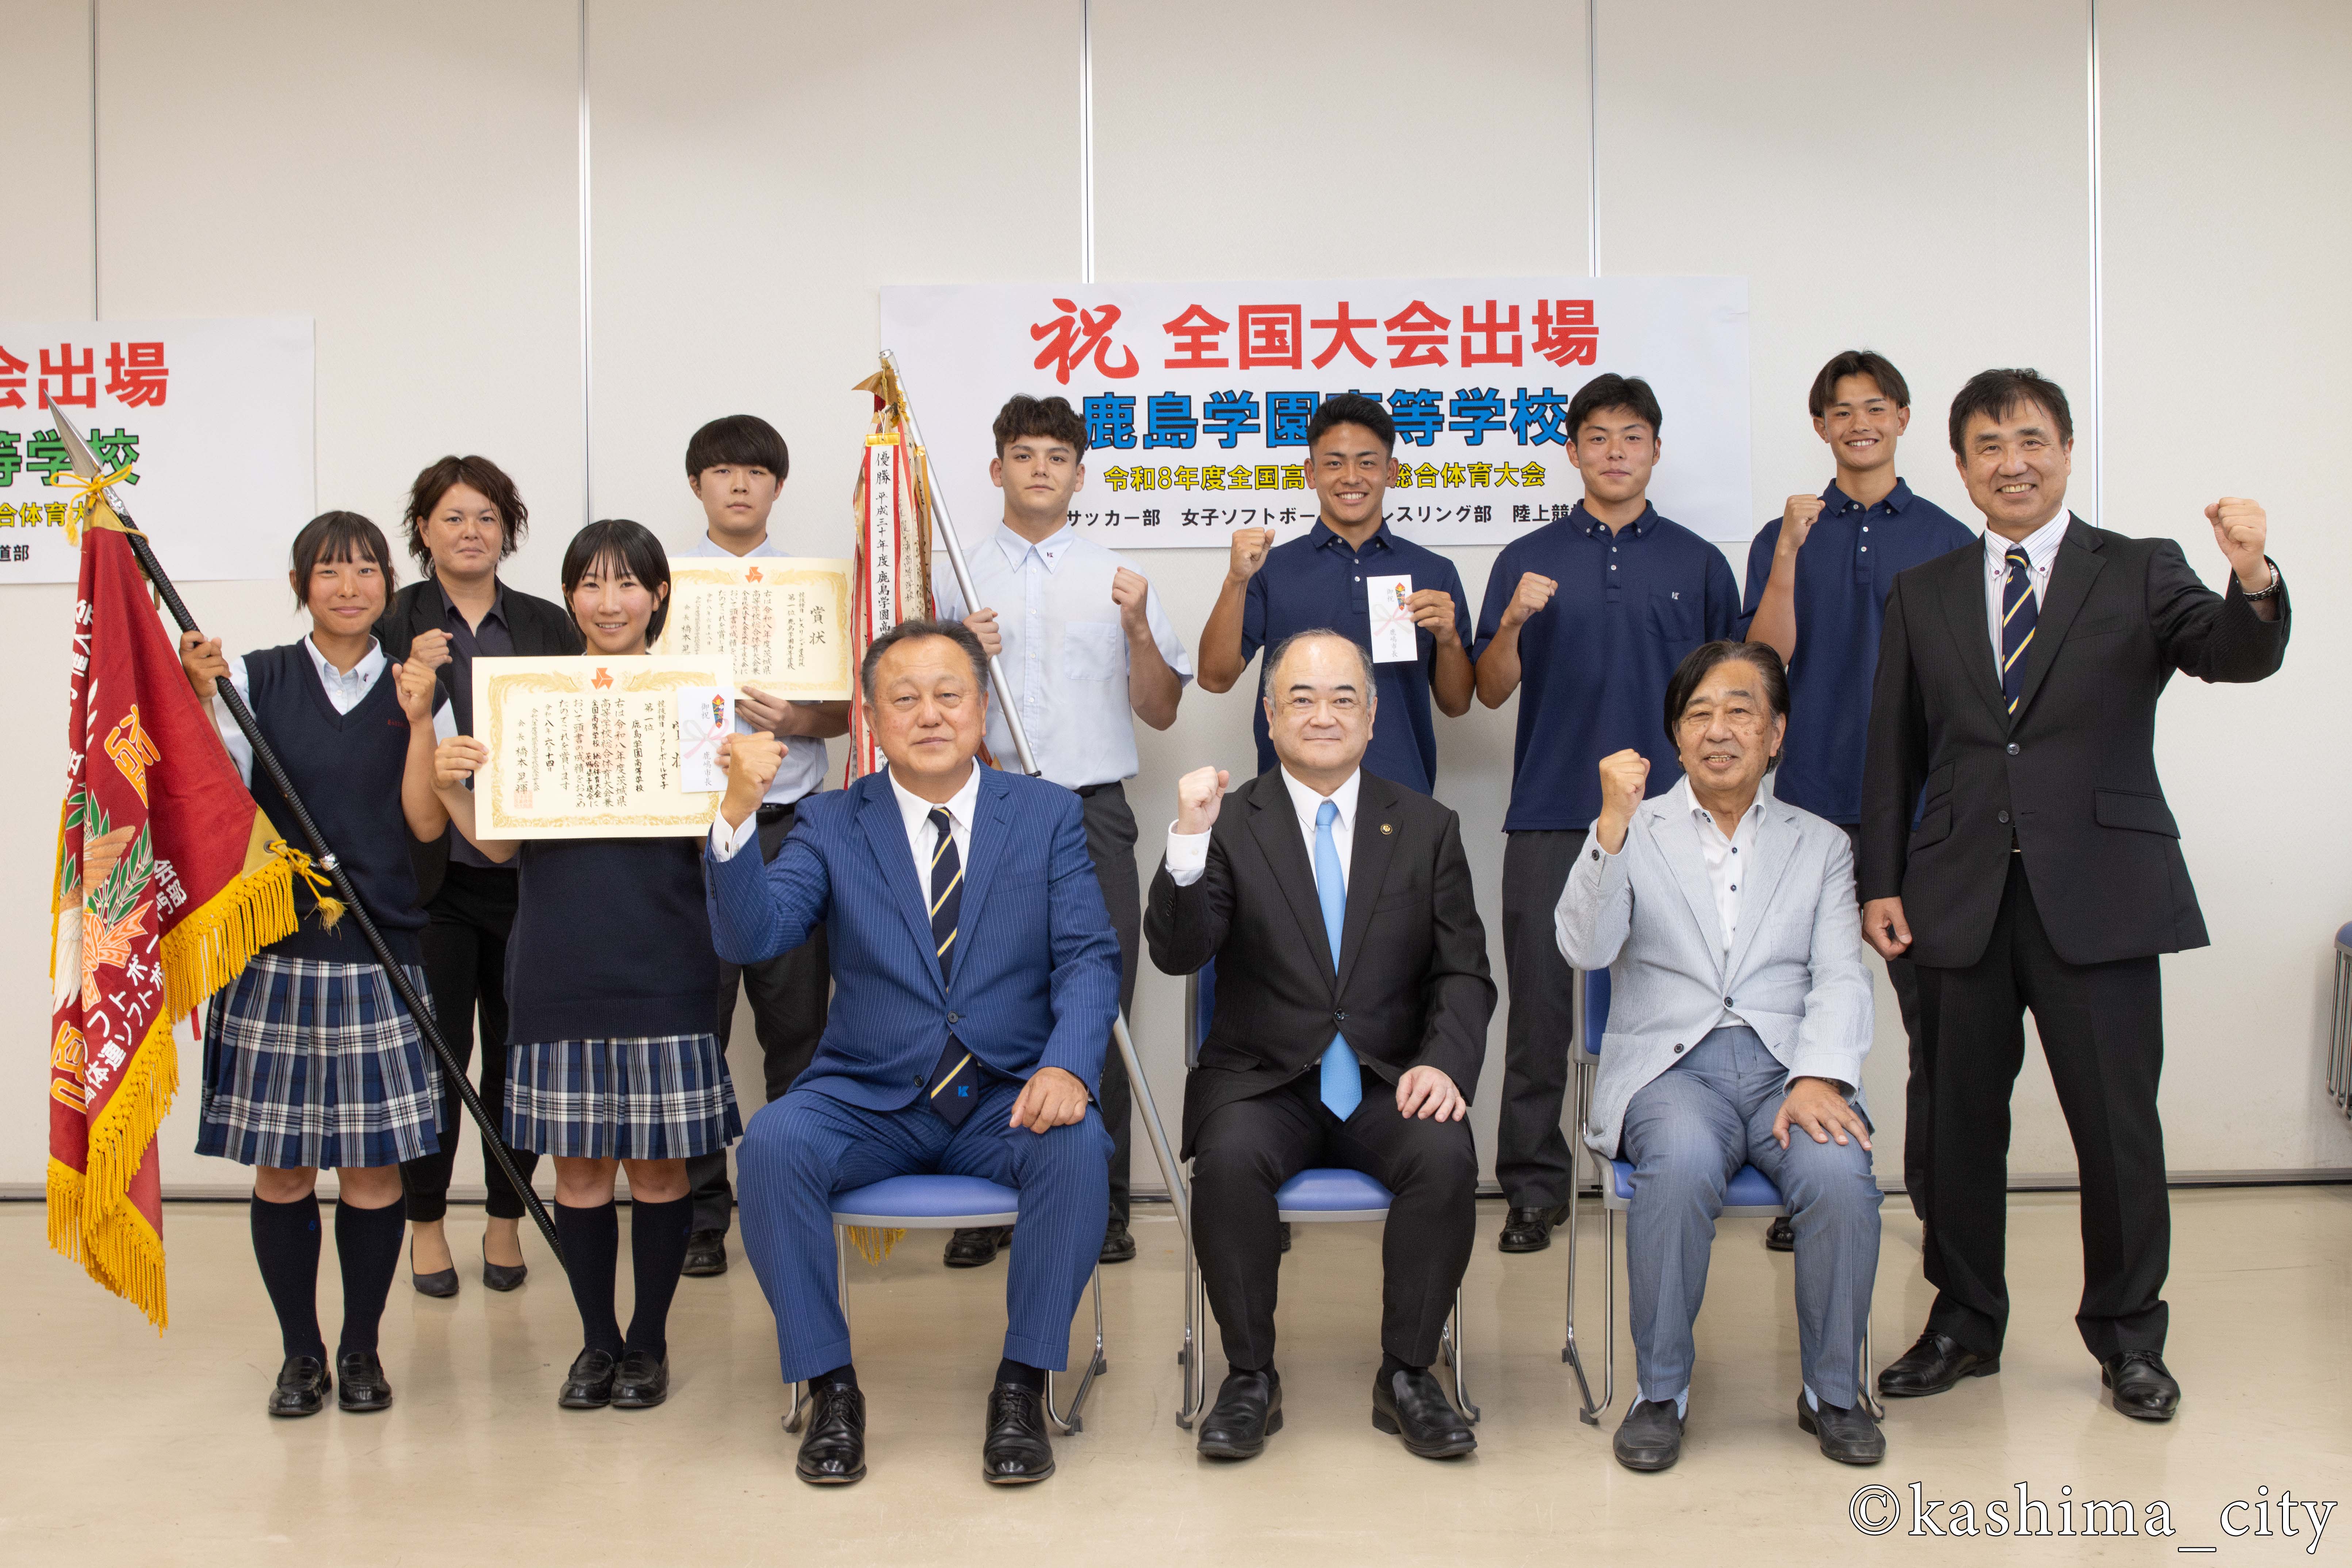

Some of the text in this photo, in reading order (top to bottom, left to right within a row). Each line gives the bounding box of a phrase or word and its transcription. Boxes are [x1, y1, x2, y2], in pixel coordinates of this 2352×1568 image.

[1030, 298, 1600, 385] 祝 全国大会出場
[1083, 387, 1568, 449] 鹿島学園等学校
[876, 451, 891, 636] 優勝 平成三十年度 鹿島学園高
[1067, 508, 1161, 527] サッカー部
[1181, 507, 1315, 526] 女子ソフトボー
[1512, 504, 1579, 523] 陸上競
[809, 605, 826, 645] 賞状
[644, 703, 654, 731] 第一位
[701, 703, 710, 720] 御祝
[559, 699, 570, 791] たのでこれを賞します
[574, 699, 585, 808] おいて頭書の成績をおさめ
[601, 698, 614, 808] 高等学校総合体育大会兼
[614, 698, 627, 807] 右は令和八年度茨城県
[703, 751, 712, 786] 鹿嶋市長
[958, 1086, 970, 1097] K
